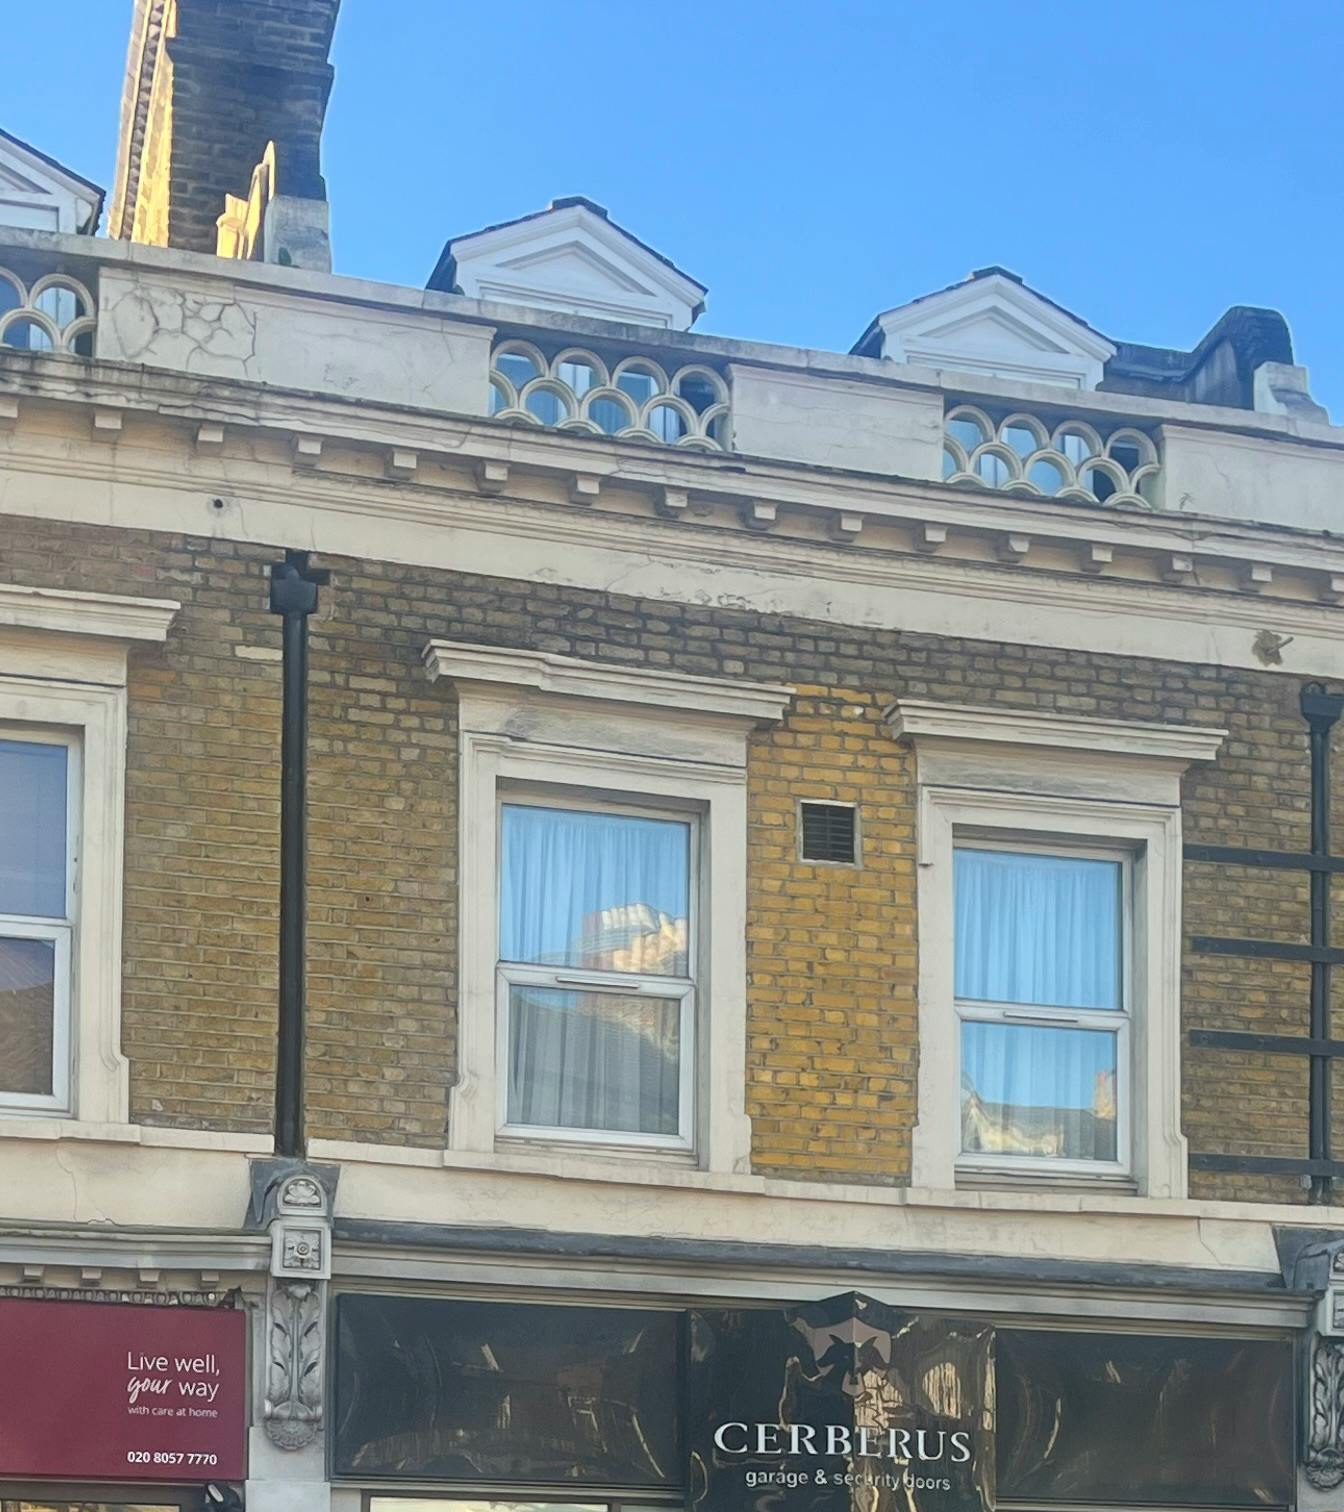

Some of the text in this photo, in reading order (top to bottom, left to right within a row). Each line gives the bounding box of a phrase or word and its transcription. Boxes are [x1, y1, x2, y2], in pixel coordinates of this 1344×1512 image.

[127, 1351, 220, 1376] Live well,
[127, 1376, 220, 1404] your way
[128, 1405, 218, 1418] with care at home
[713, 1421, 972, 1463] CERBERUS
[127, 1451, 218, 1465] 020 8057 7770
[745, 1469, 952, 1492] garage & security doors
